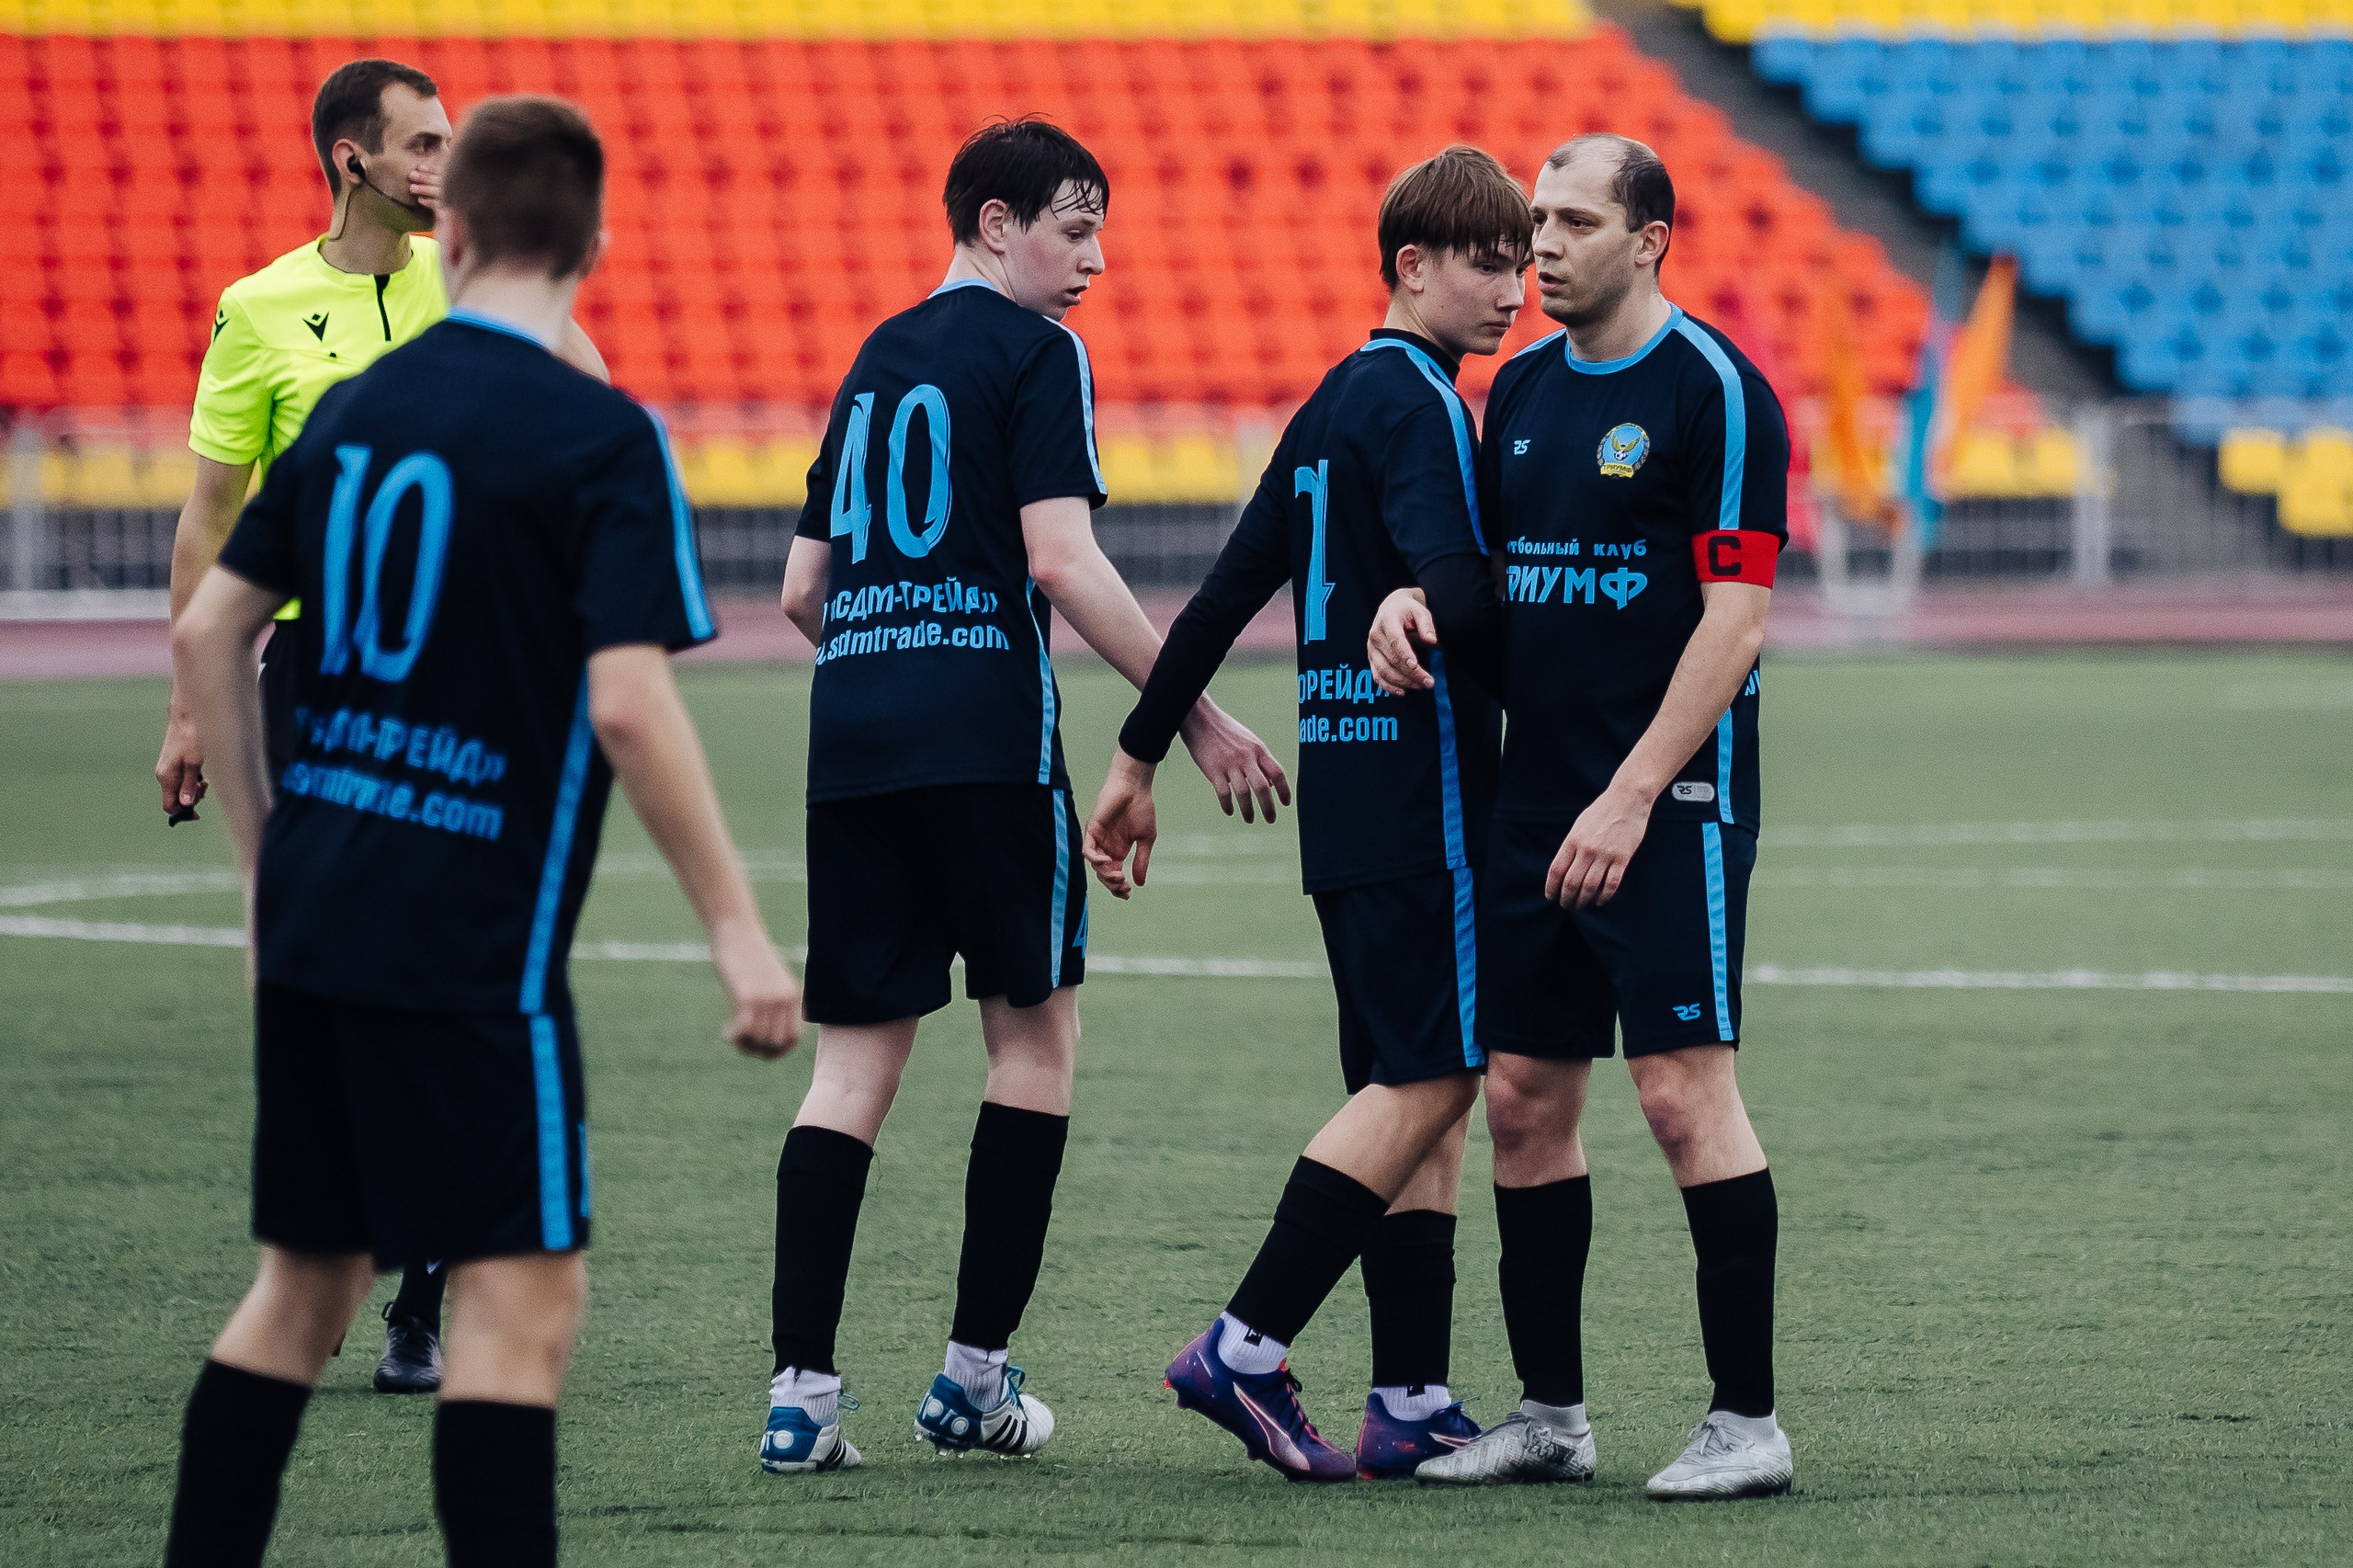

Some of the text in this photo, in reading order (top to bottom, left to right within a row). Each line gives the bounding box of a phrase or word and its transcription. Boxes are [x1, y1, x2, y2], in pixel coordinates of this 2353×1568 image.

[830, 383, 951, 564] 40
[321, 443, 454, 683] 10
[1294, 460, 1336, 644] 1
[1506, 536, 1648, 561] тбольный клуб
[1506, 565, 1648, 611] РИУМФ
[1708, 535, 1742, 577] C
